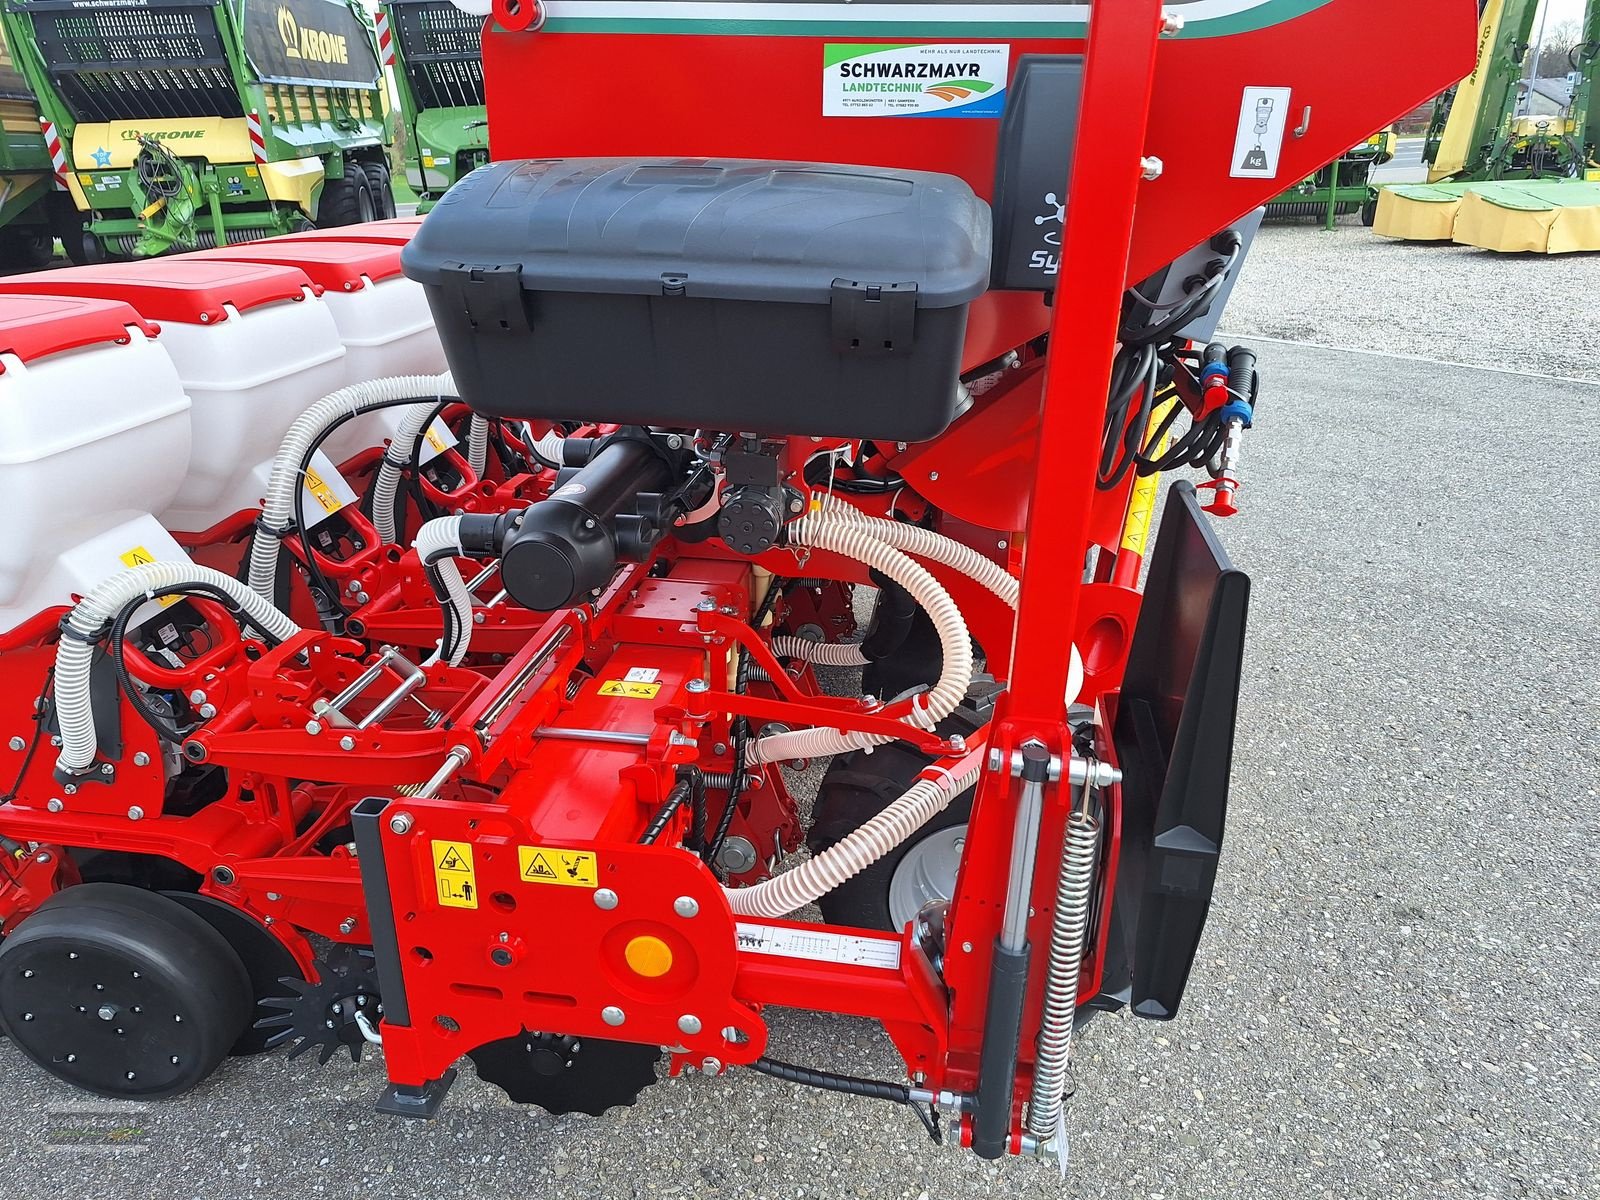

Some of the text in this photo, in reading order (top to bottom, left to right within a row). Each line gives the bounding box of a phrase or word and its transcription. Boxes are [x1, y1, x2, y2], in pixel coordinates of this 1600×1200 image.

[72, 0, 148, 8] www.schwarzmayr.at
[300, 27, 349, 65] KRONE
[1469, 40, 1486, 86] KRONE
[840, 63, 980, 78] SCHWARZMAYR
[842, 83, 923, 92] LANDTECHNIK
[143, 130, 205, 140] KRONE
[1250, 157, 1262, 167] kg
